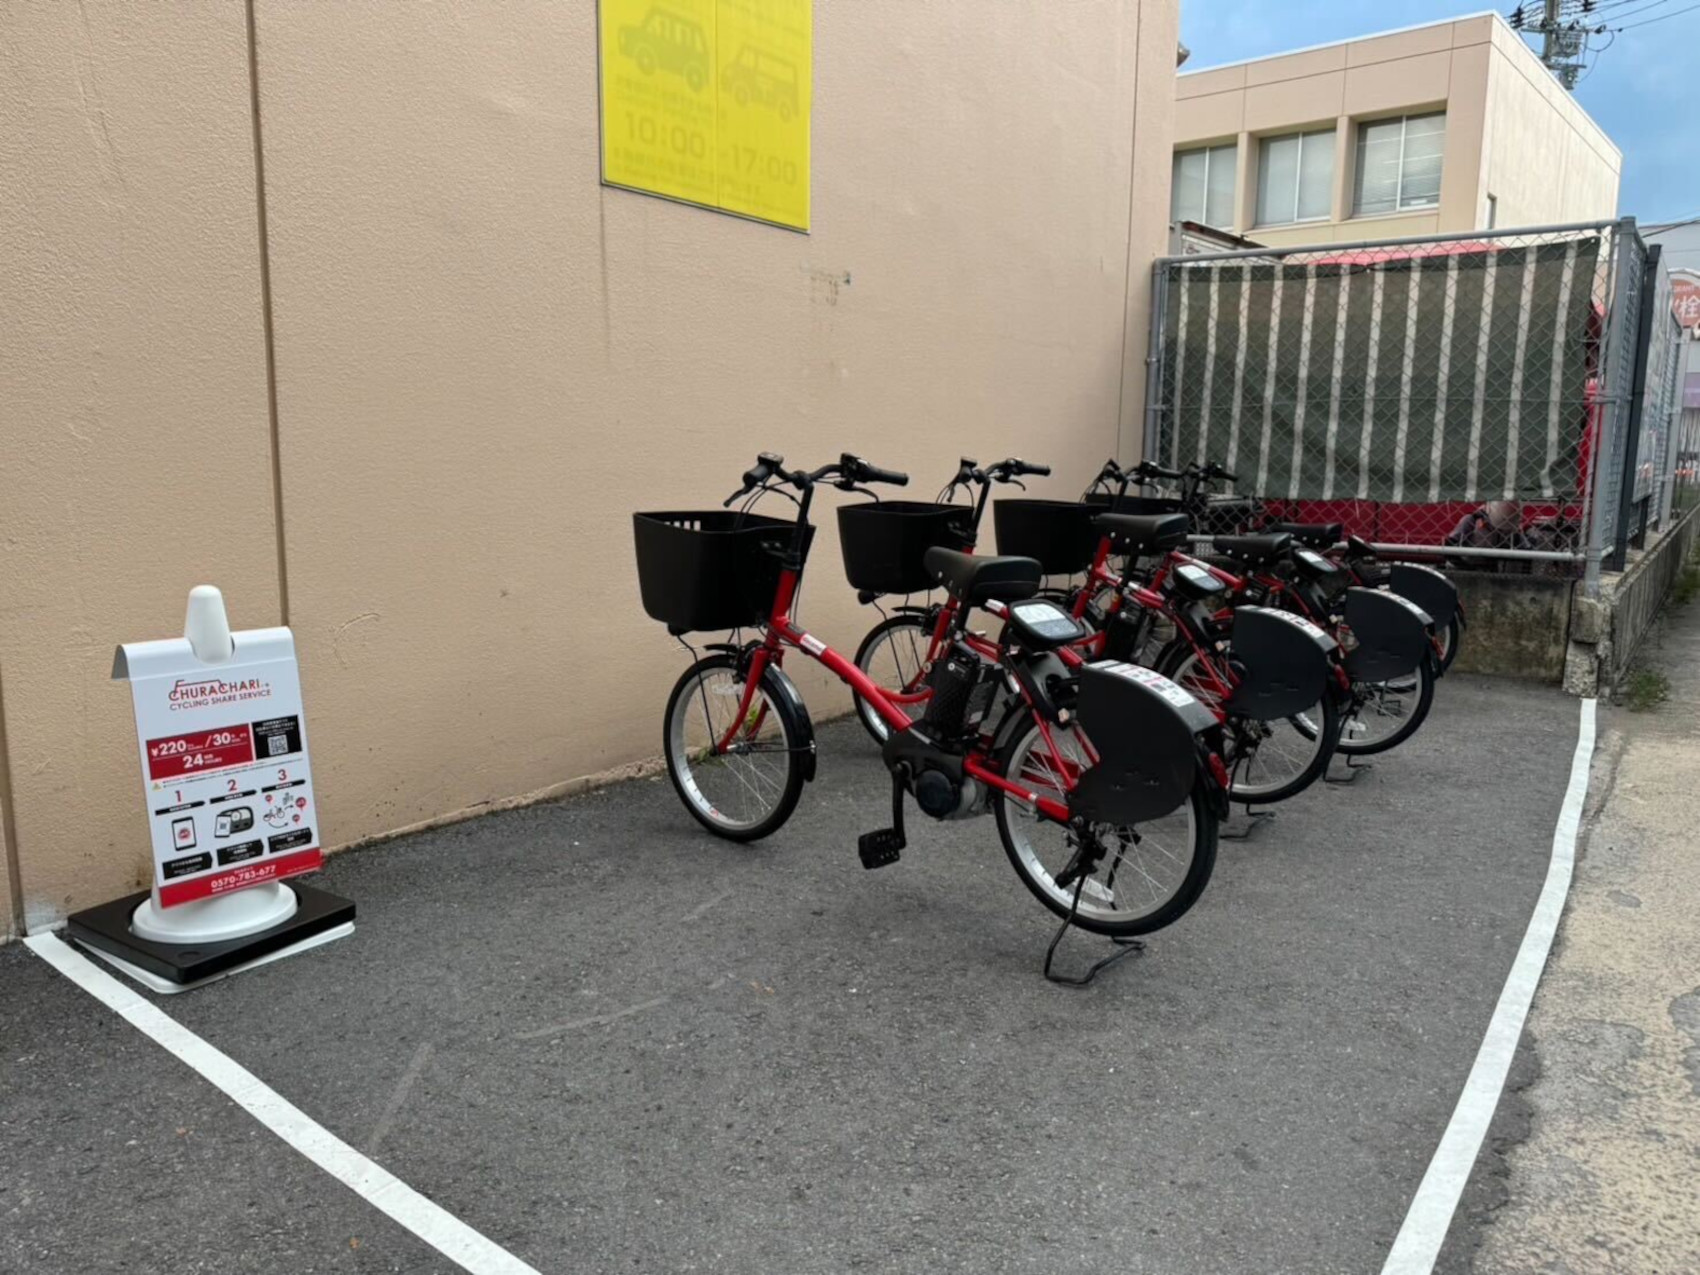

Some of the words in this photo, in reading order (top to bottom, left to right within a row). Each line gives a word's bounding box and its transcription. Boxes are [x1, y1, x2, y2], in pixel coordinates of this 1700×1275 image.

[625, 110, 705, 160] 10:00
[731, 143, 797, 187] 17:00
[1674, 294, 1700, 319] 栓
[168, 679, 260, 701] CHURACHARI
[169, 698, 209, 711] CYCLING
[211, 694, 237, 706] SHARE
[239, 688, 272, 700] SERVICE
[183, 753, 204, 769] 24
[226, 779, 237, 792] 2
[277, 769, 287, 781] 3
[174, 790, 182, 803] 1
